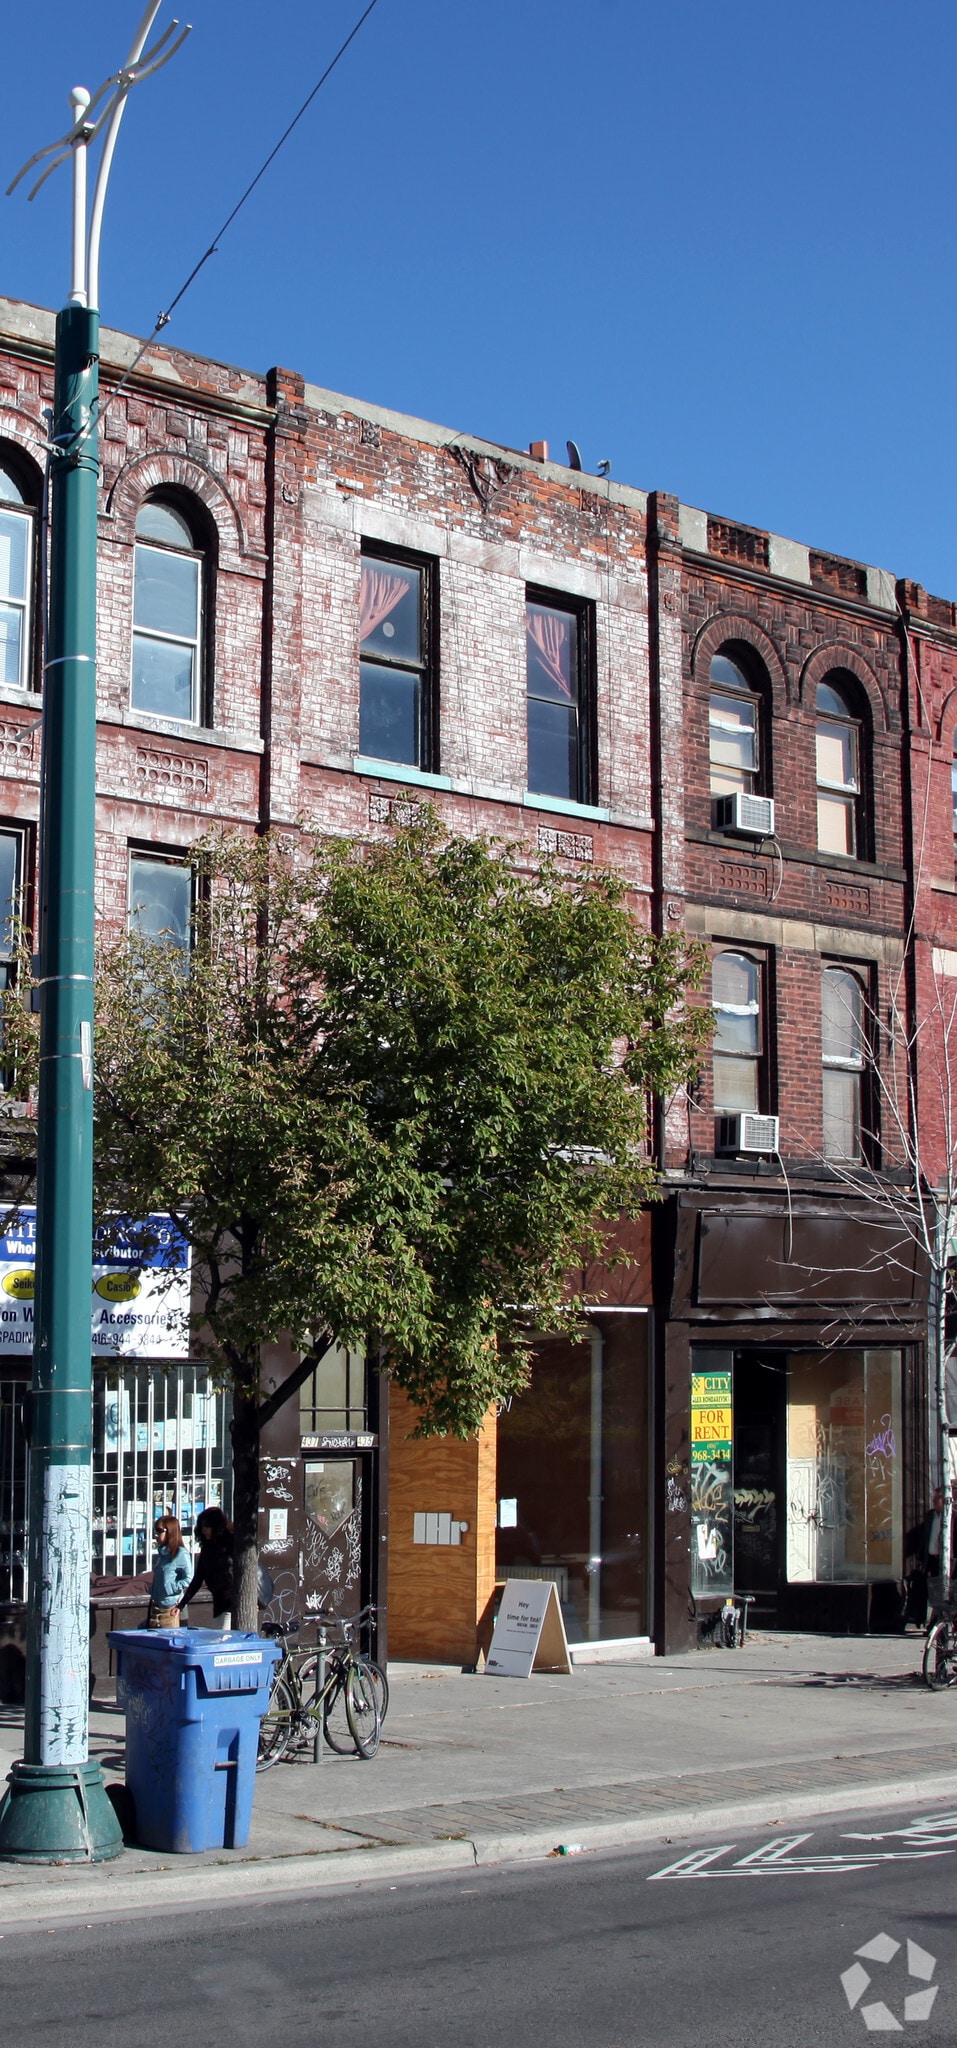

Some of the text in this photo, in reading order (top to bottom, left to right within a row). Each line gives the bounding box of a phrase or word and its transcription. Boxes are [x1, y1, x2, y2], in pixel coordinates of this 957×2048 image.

[13, 1277, 35, 1289] Seik
[106, 1280, 131, 1292] Casio
[100, 1309, 172, 1325] Accessories
[704, 1377, 731, 1390] CITY
[699, 1410, 724, 1424] FOR
[694, 1425, 729, 1440] RENT
[692, 1449, 731, 1461] 968-3434
[518, 1601, 530, 1609] Hey
[506, 1613, 520, 1621] time
[520, 1614, 529, 1622] for
[215, 1654, 261, 1664] GARBAGE ONLY
